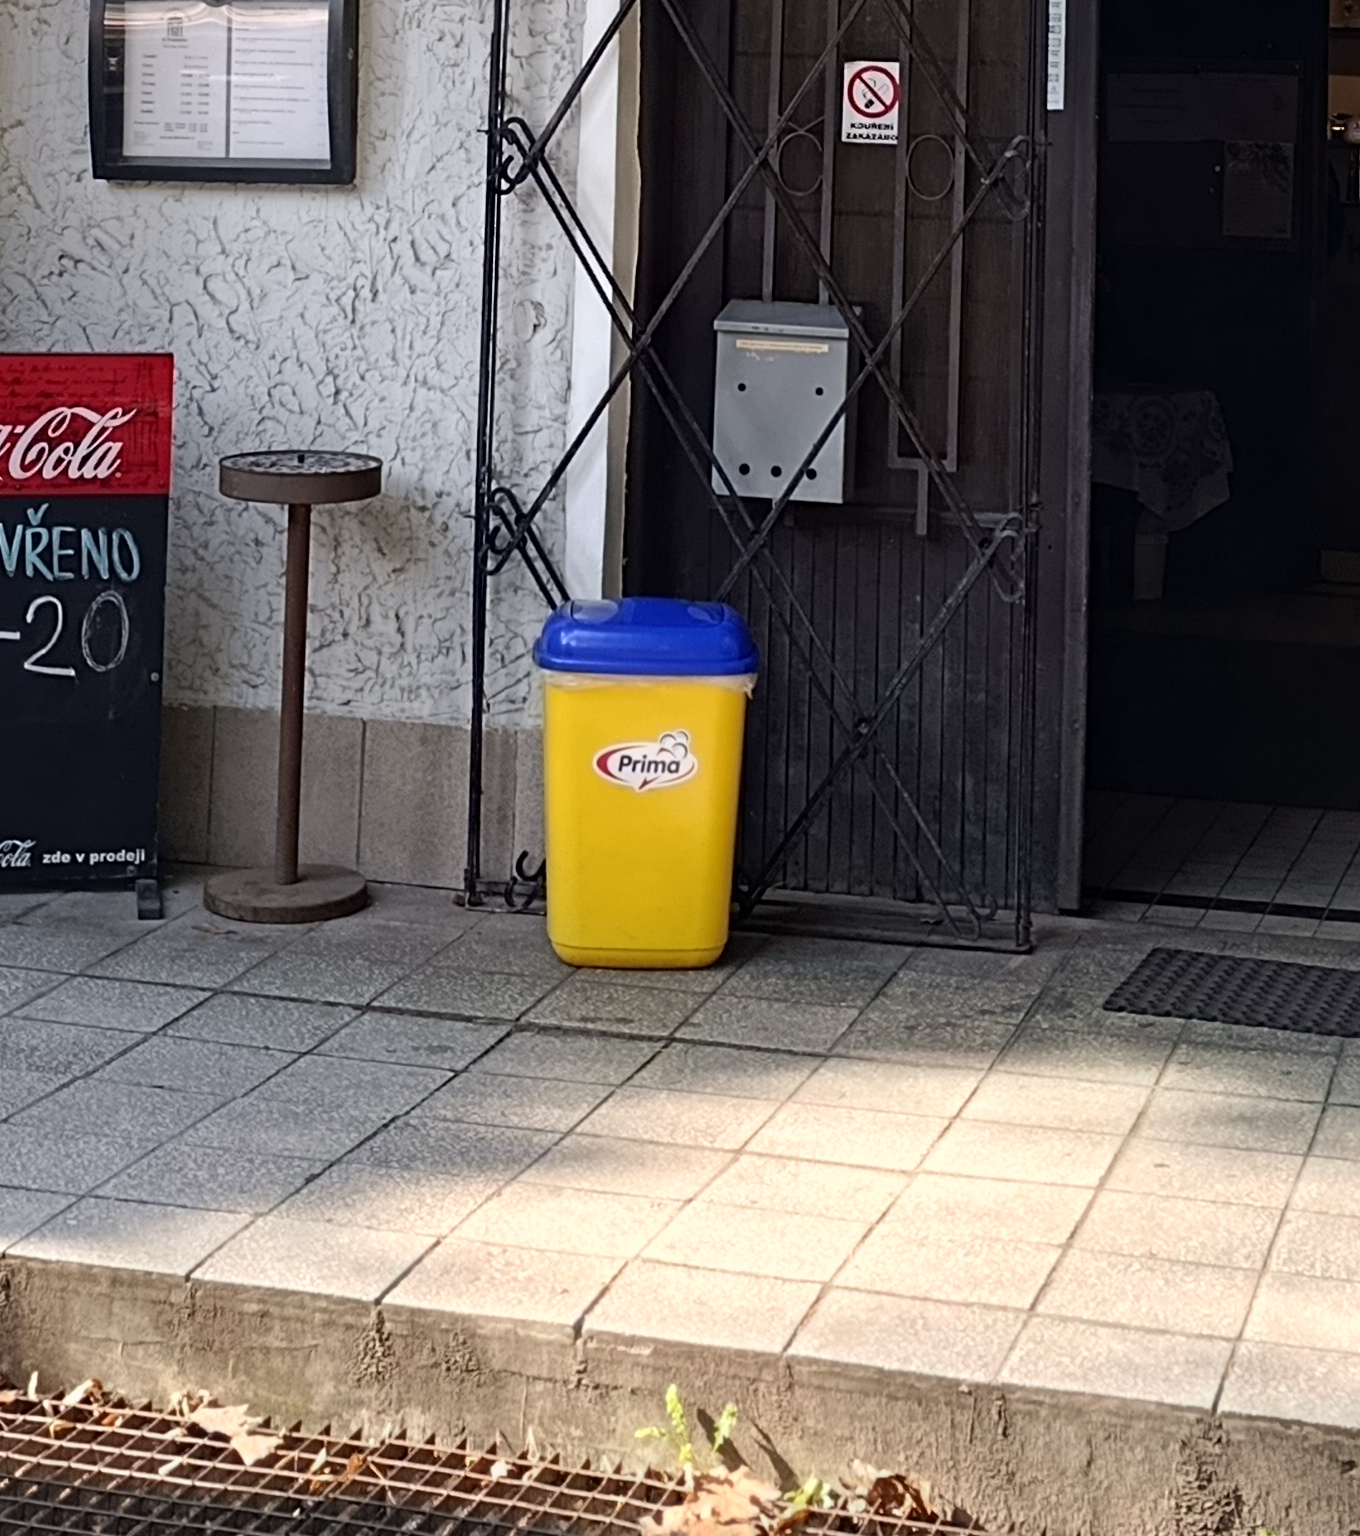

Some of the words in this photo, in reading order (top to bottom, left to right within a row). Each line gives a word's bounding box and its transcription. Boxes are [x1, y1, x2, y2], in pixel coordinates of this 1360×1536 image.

[618, 754, 681, 774] Prima
[42, 850, 71, 865] zde
[75, 852, 86, 864] v
[89, 848, 146, 866] prodeji
